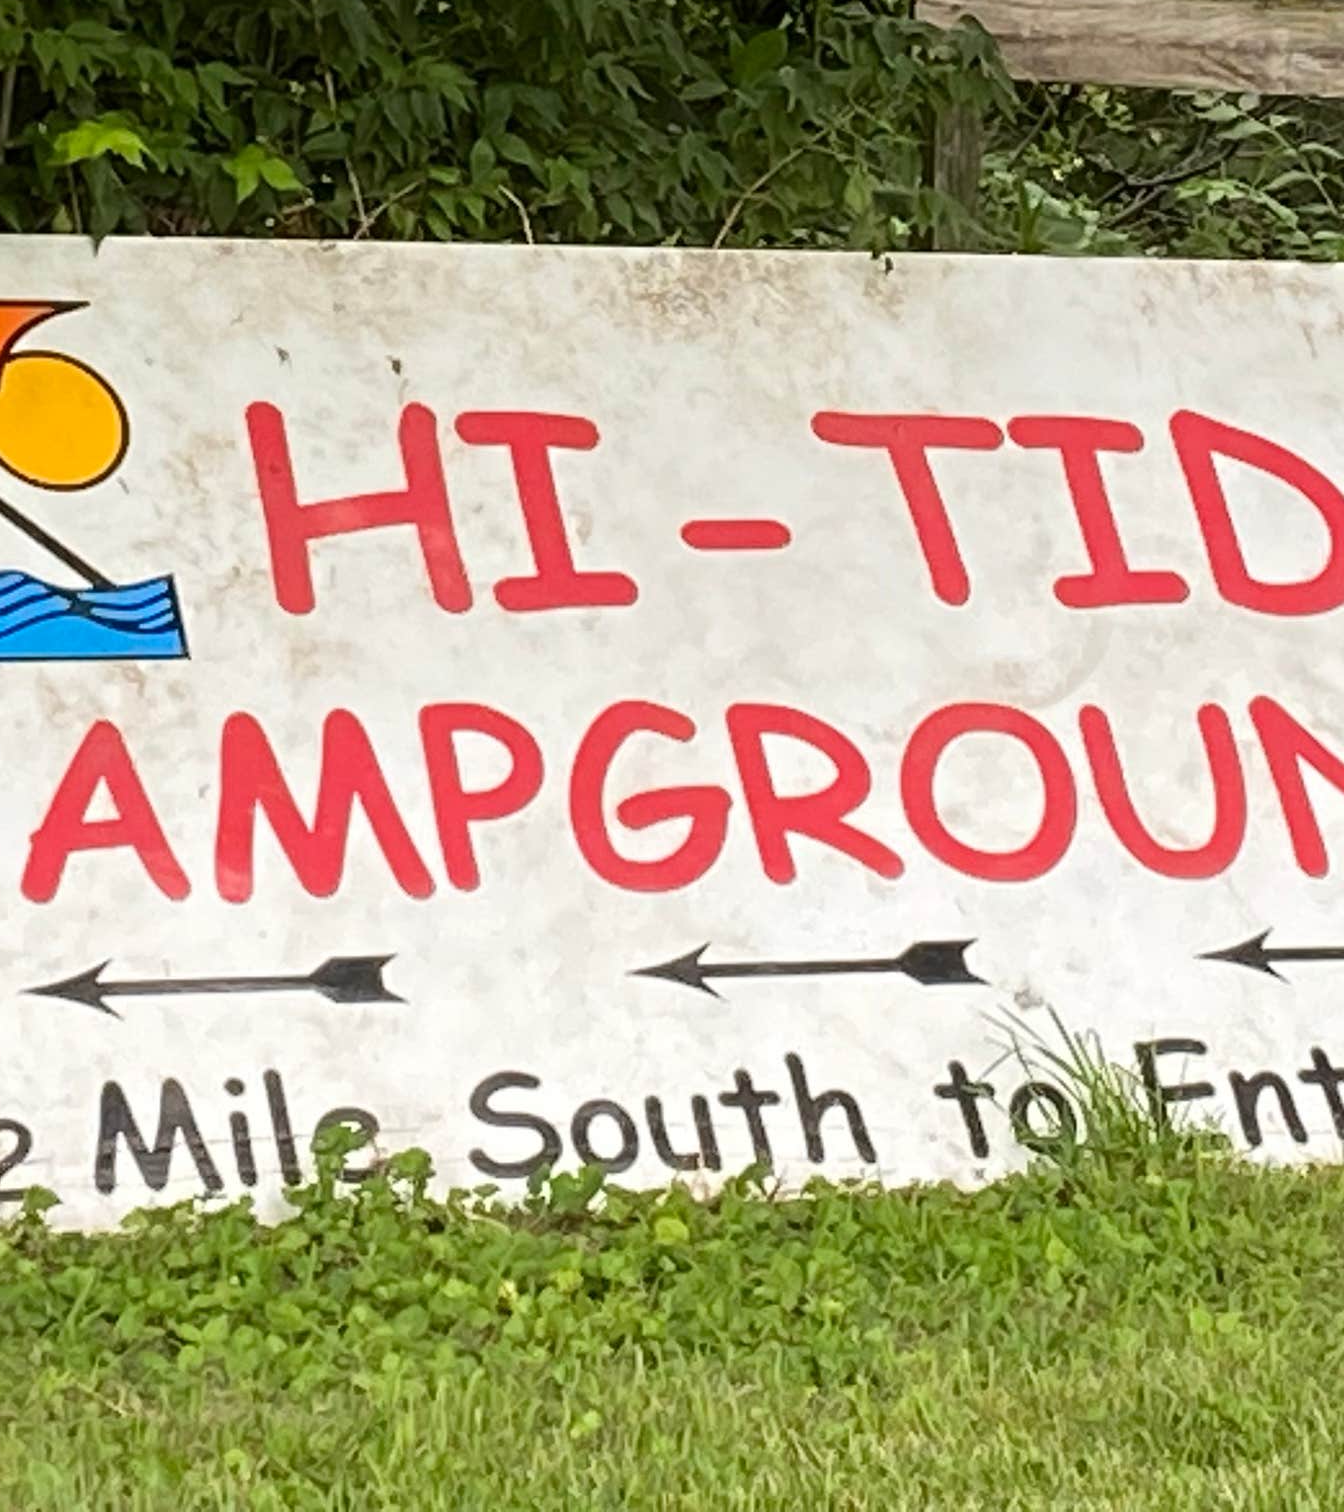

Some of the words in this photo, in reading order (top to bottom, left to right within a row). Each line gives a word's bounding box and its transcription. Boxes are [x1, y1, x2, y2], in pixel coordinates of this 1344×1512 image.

[244, 399, 639, 615] HI
[93, 1068, 384, 1195] Mile
[467, 1051, 880, 1180] South
[933, 1059, 1080, 1160] to
